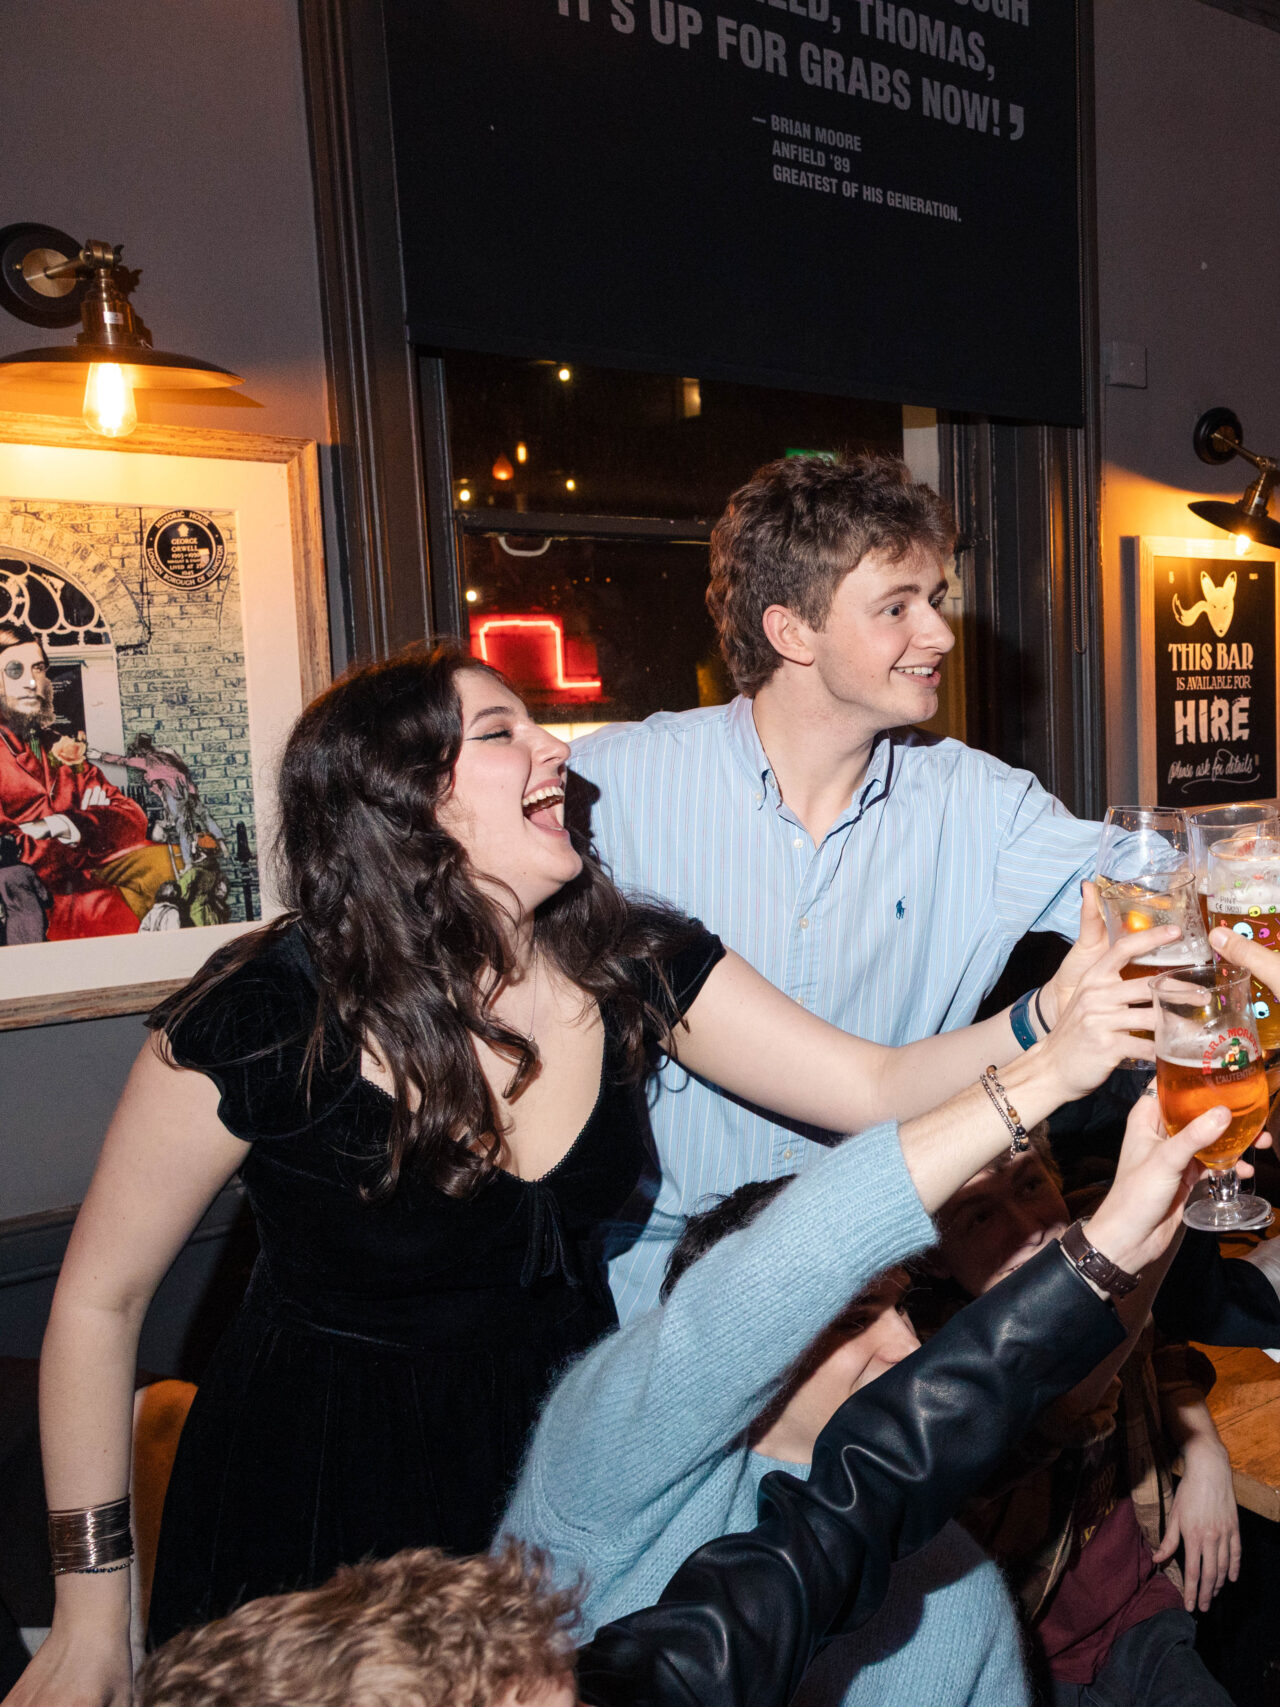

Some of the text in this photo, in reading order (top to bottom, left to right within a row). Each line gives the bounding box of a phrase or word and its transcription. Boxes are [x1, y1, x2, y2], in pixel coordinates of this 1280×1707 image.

[647, 0, 703, 50] UP
[716, 15, 788, 77] FOR
[799, 41, 911, 111] GRABS
[856, 0, 996, 81] THOMAS,
[770, 114, 862, 153] BRIAN MOORE
[772, 140, 826, 169] ANFIELD
[772, 164, 962, 222] GREATEST OF HIS GENERATION.
[171, 537, 198, 545] GEORGE
[147, 547, 164, 575] LONDON
[163, 573, 196, 586] BOROUGH
[1168, 642, 1254, 672] THIS BAR
[1176, 675, 1252, 691] IS AVAILABLE FOR
[1174, 695, 1251, 745] HIRE
[1168, 751, 1254, 785] please ask for details
[1202, 1034, 1227, 1075] BIRRA
